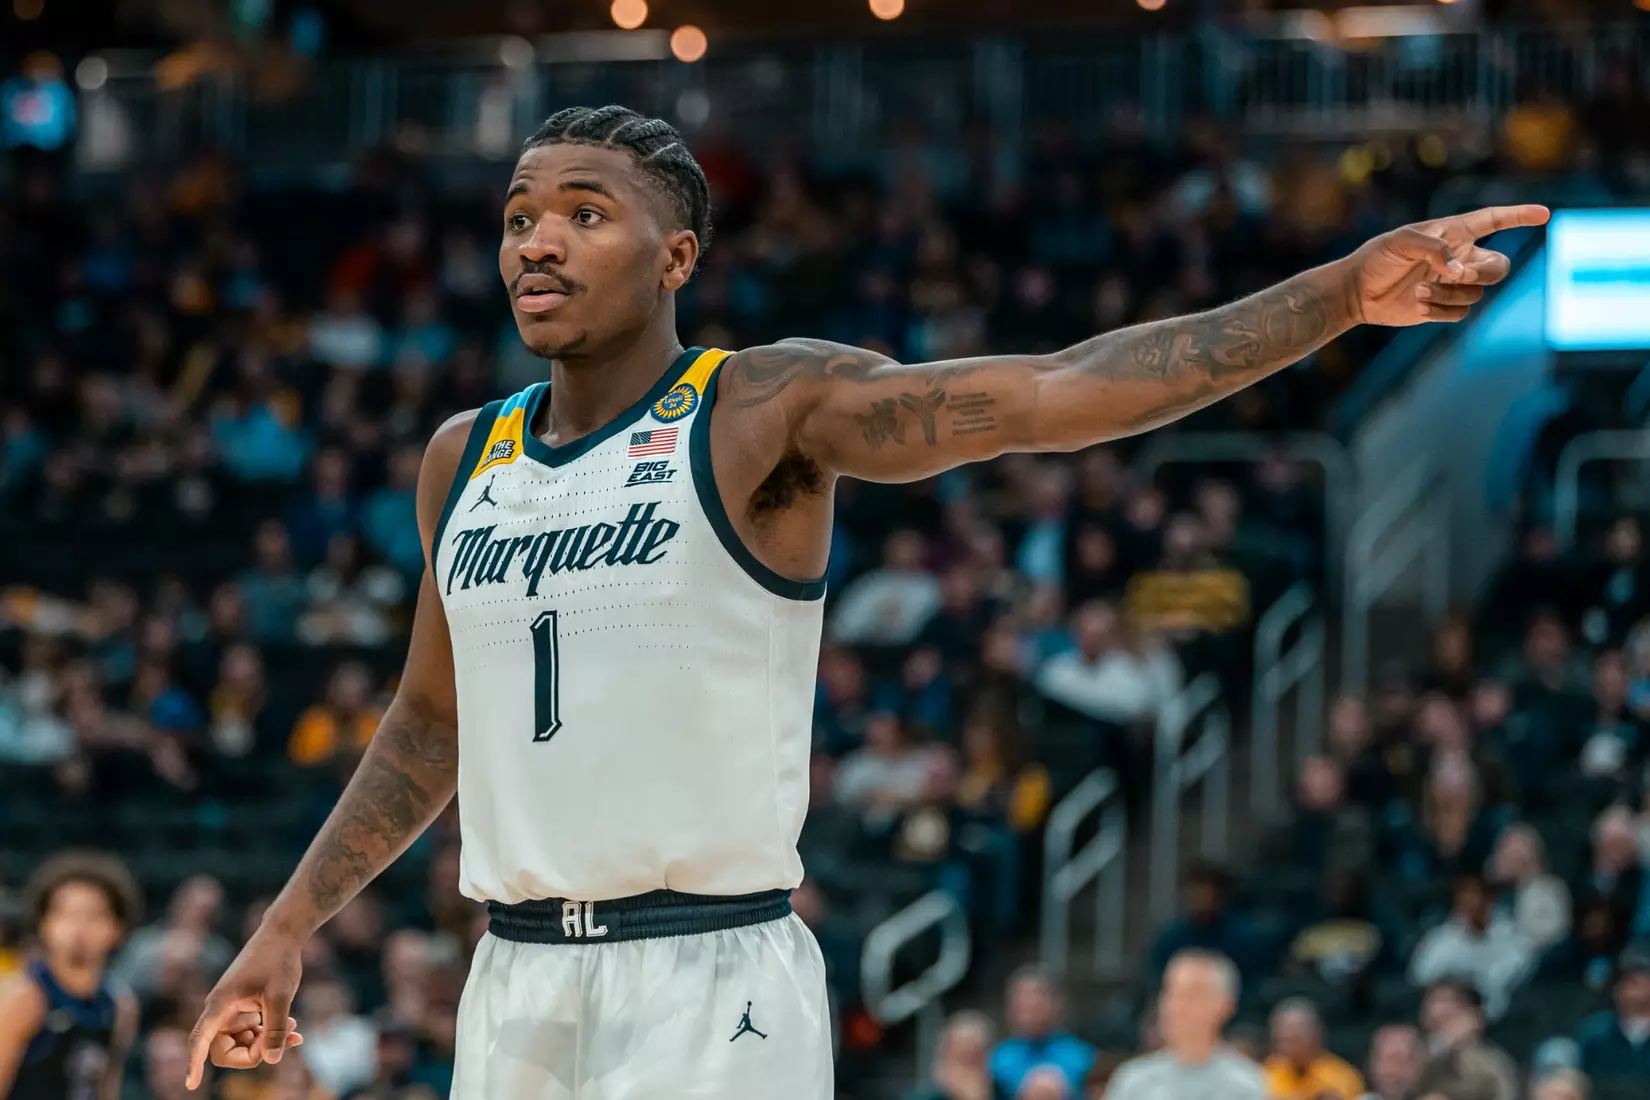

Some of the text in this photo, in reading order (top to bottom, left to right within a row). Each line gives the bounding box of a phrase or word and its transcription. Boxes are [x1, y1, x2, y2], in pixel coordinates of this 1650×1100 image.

[493, 440, 514, 452] THE
[483, 449, 513, 465] ANGE
[633, 460, 670, 473] BIG
[626, 469, 678, 482] EAST
[447, 501, 680, 597] Marquette
[529, 609, 563, 742] 1
[562, 900, 608, 937] AL
